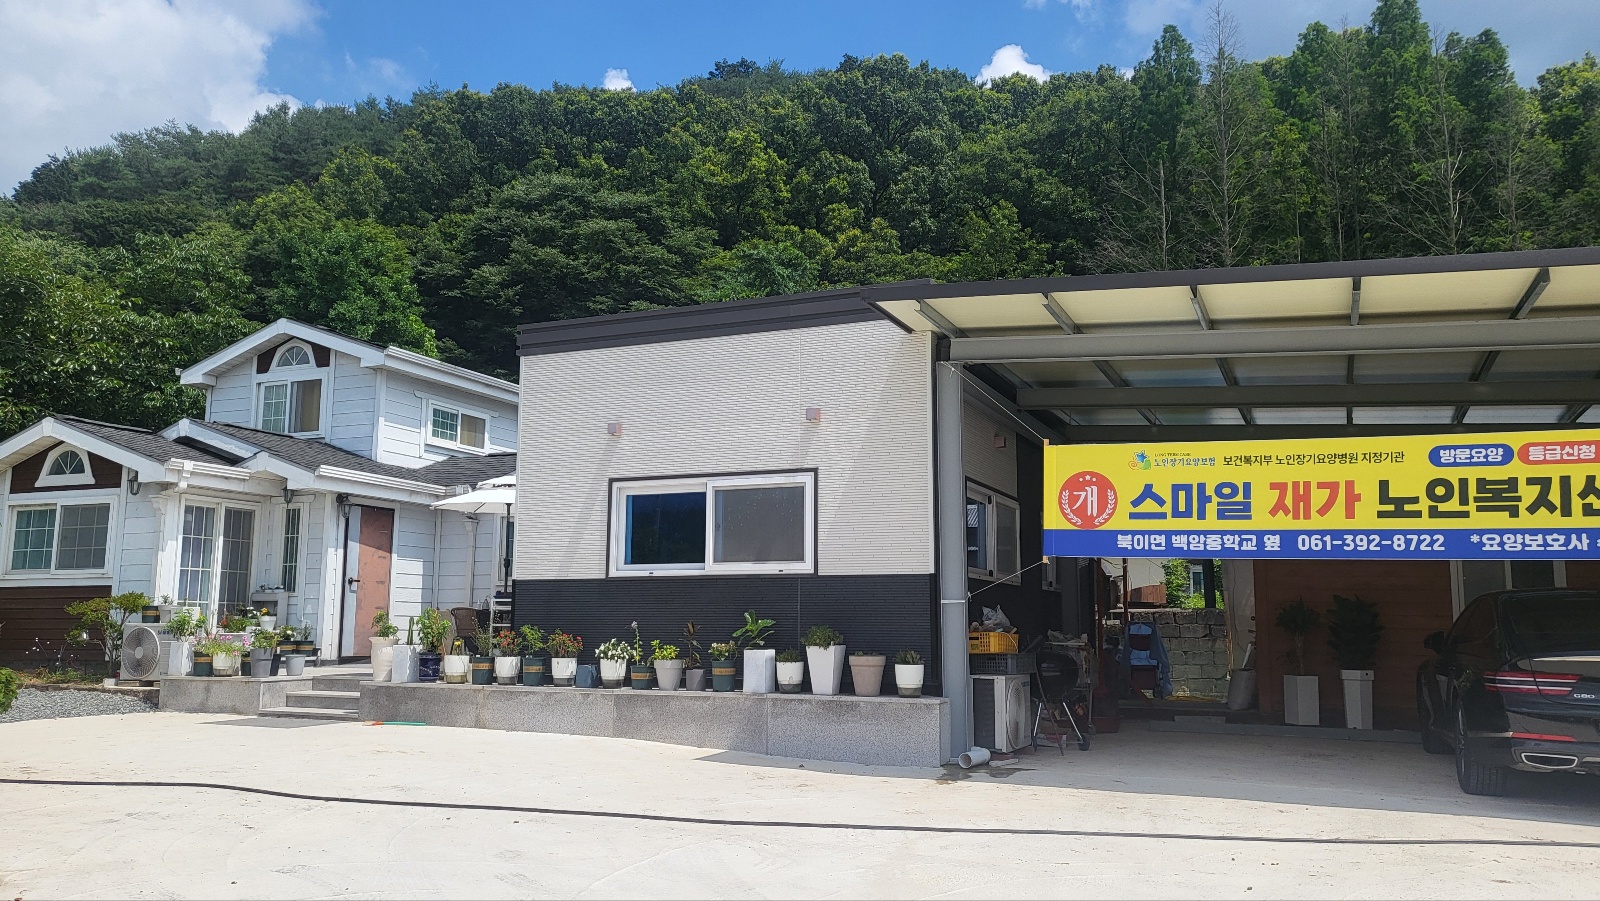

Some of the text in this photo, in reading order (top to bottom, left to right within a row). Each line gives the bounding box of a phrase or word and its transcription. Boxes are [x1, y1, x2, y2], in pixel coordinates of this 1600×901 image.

[1223, 451, 1405, 467] 보건복지부 노인장기요양병원 지정기관
[1439, 448, 1503, 463] 방문요양
[1528, 444, 1596, 461] 등급신청
[1154, 456, 1216, 467] 노인장기요양보험
[1072, 485, 1098, 517] 개
[1128, 481, 1253, 521] 스마일
[1268, 480, 1362, 520] 재가
[1116, 534, 1167, 551] 북이면
[1171, 534, 1258, 551] 백암중학교
[1263, 534, 1281, 551] 옆
[1297, 534, 1446, 551] 061-392-8722
